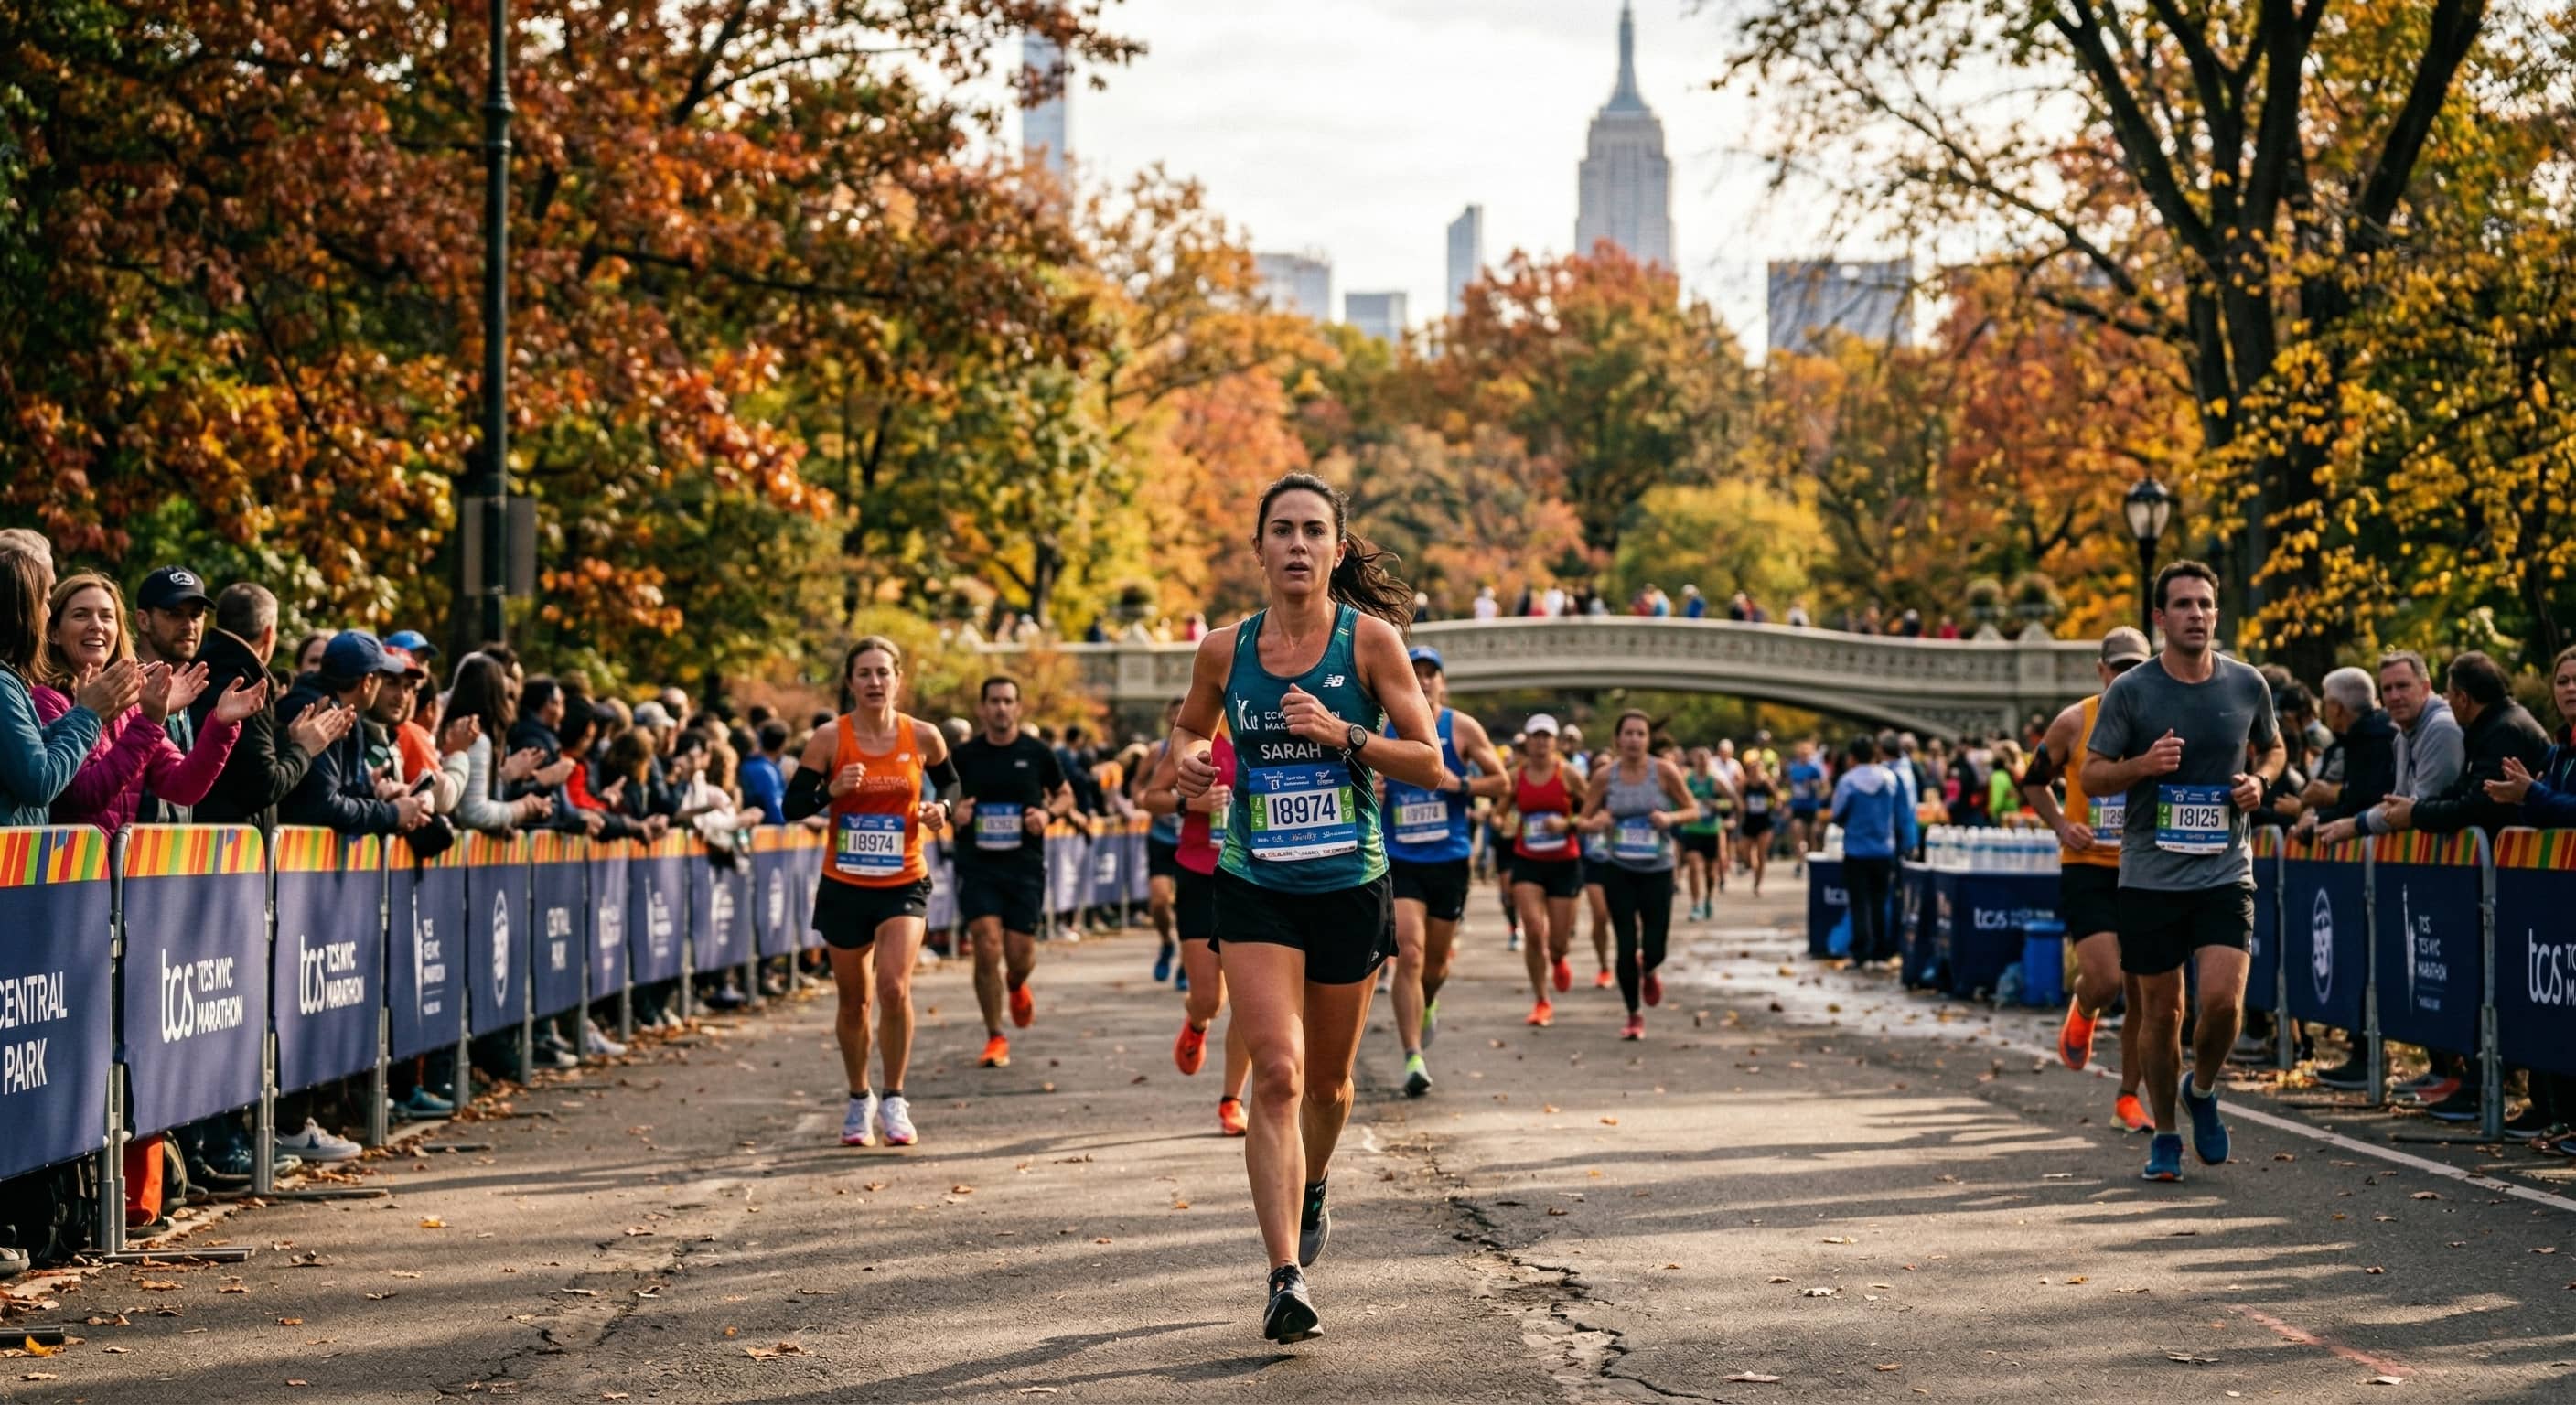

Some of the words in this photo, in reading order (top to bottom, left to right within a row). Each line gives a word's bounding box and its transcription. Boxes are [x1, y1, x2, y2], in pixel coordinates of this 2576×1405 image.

[1261, 743, 1322, 760] SARAH
[1272, 793, 1336, 825] 18974
[2179, 808, 2219, 828] 18125
[853, 834, 893, 853] 18974
[197, 959, 215, 992] TCS
[215, 956, 233, 990] NYC
[326, 943, 339, 972] TCS
[340, 941, 356, 971] NYC
[2528, 928, 2562, 1005] tcs
[300, 934, 325, 1015] tcs
[326, 975, 365, 1009] MARATHON
[162, 948, 194, 1044] tcs
[197, 994, 243, 1035] MARATHON
[4, 1037, 48, 1096] PARK
